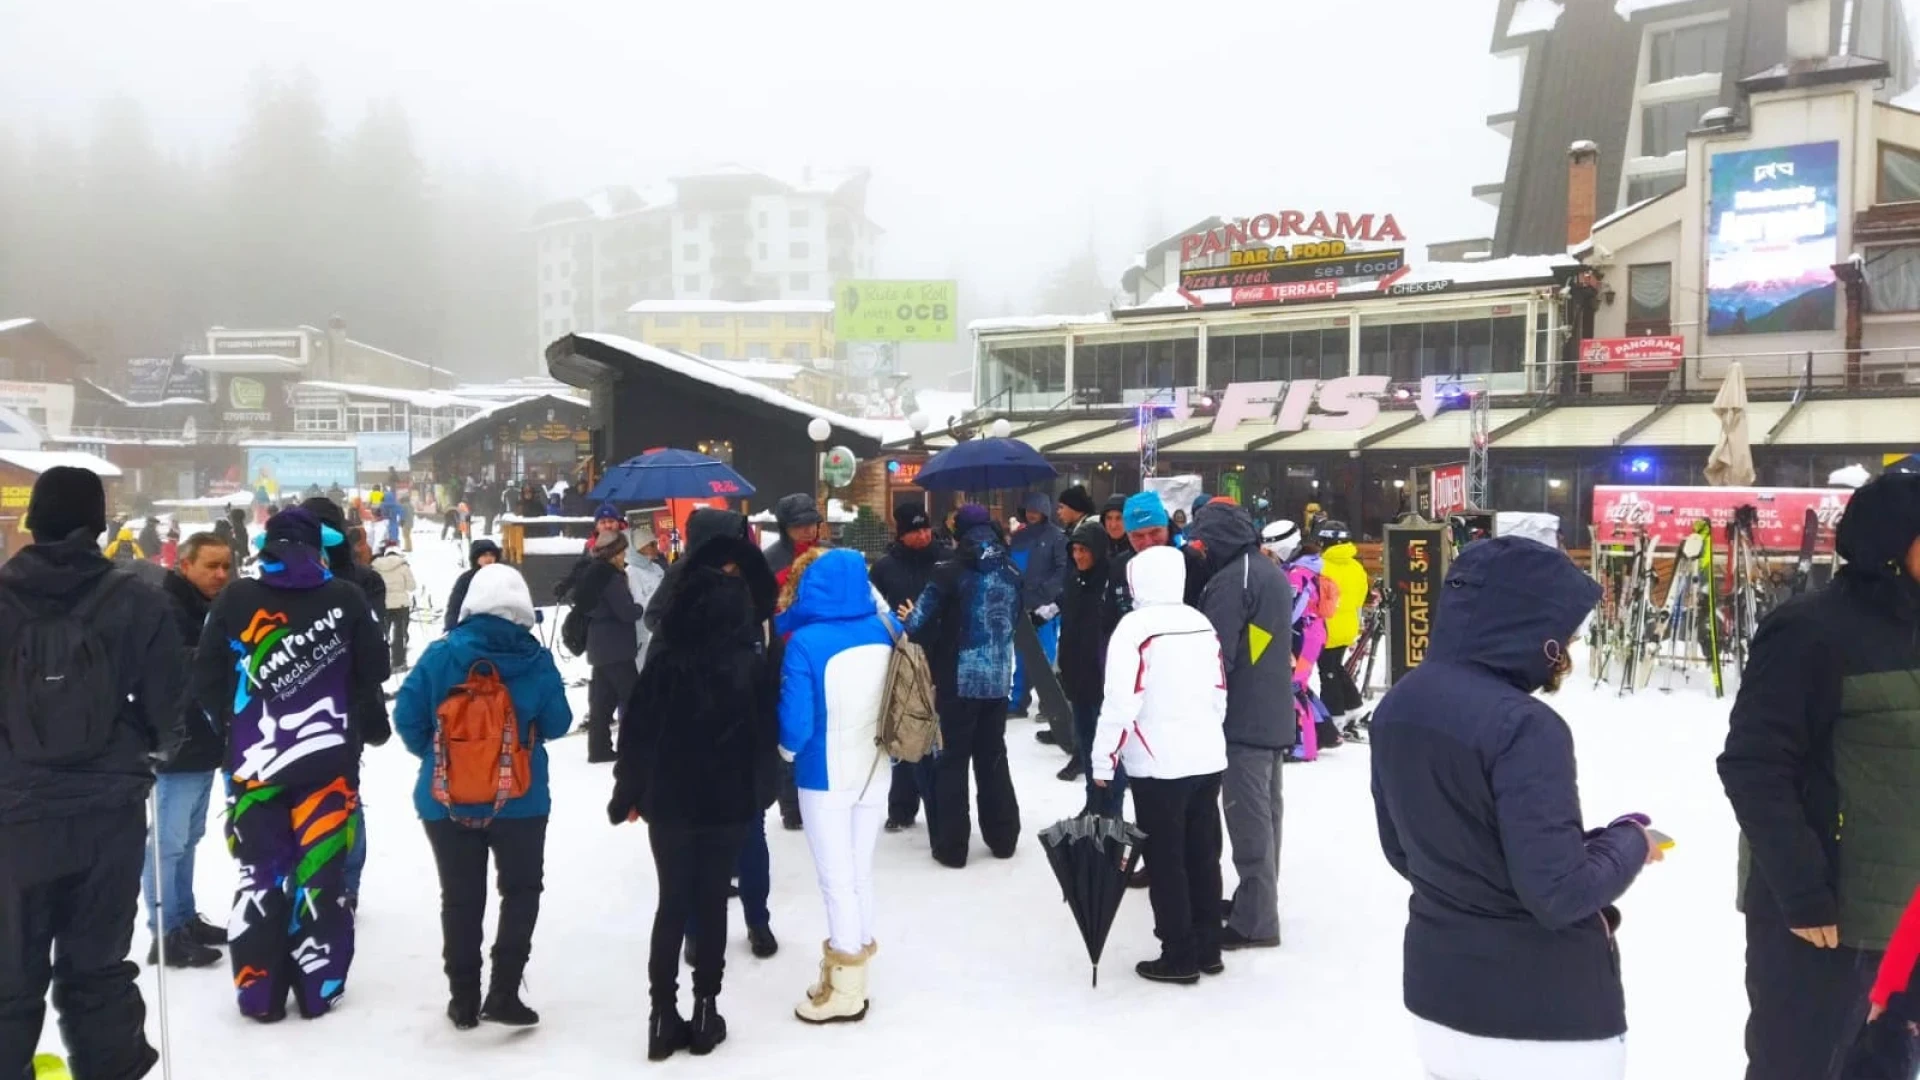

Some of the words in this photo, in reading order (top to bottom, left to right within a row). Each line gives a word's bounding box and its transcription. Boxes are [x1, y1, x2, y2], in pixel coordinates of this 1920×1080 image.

[1180, 210, 1406, 262] PANORAMA
[1230, 247, 1270, 266] BAR
[1273, 246, 1289, 262] &
[1291, 240, 1346, 260] FOOD
[1314, 267, 1345, 277] sea
[1355, 259, 1398, 274] food
[1271, 281, 1334, 297] TERRACE
[897, 303, 948, 320] OCB
[1614, 339, 1681, 355] PANORAMA
[1212, 375, 1391, 434] FIS
[1680, 508, 1709, 517] FEEL
[270, 655, 313, 693] Mechi
